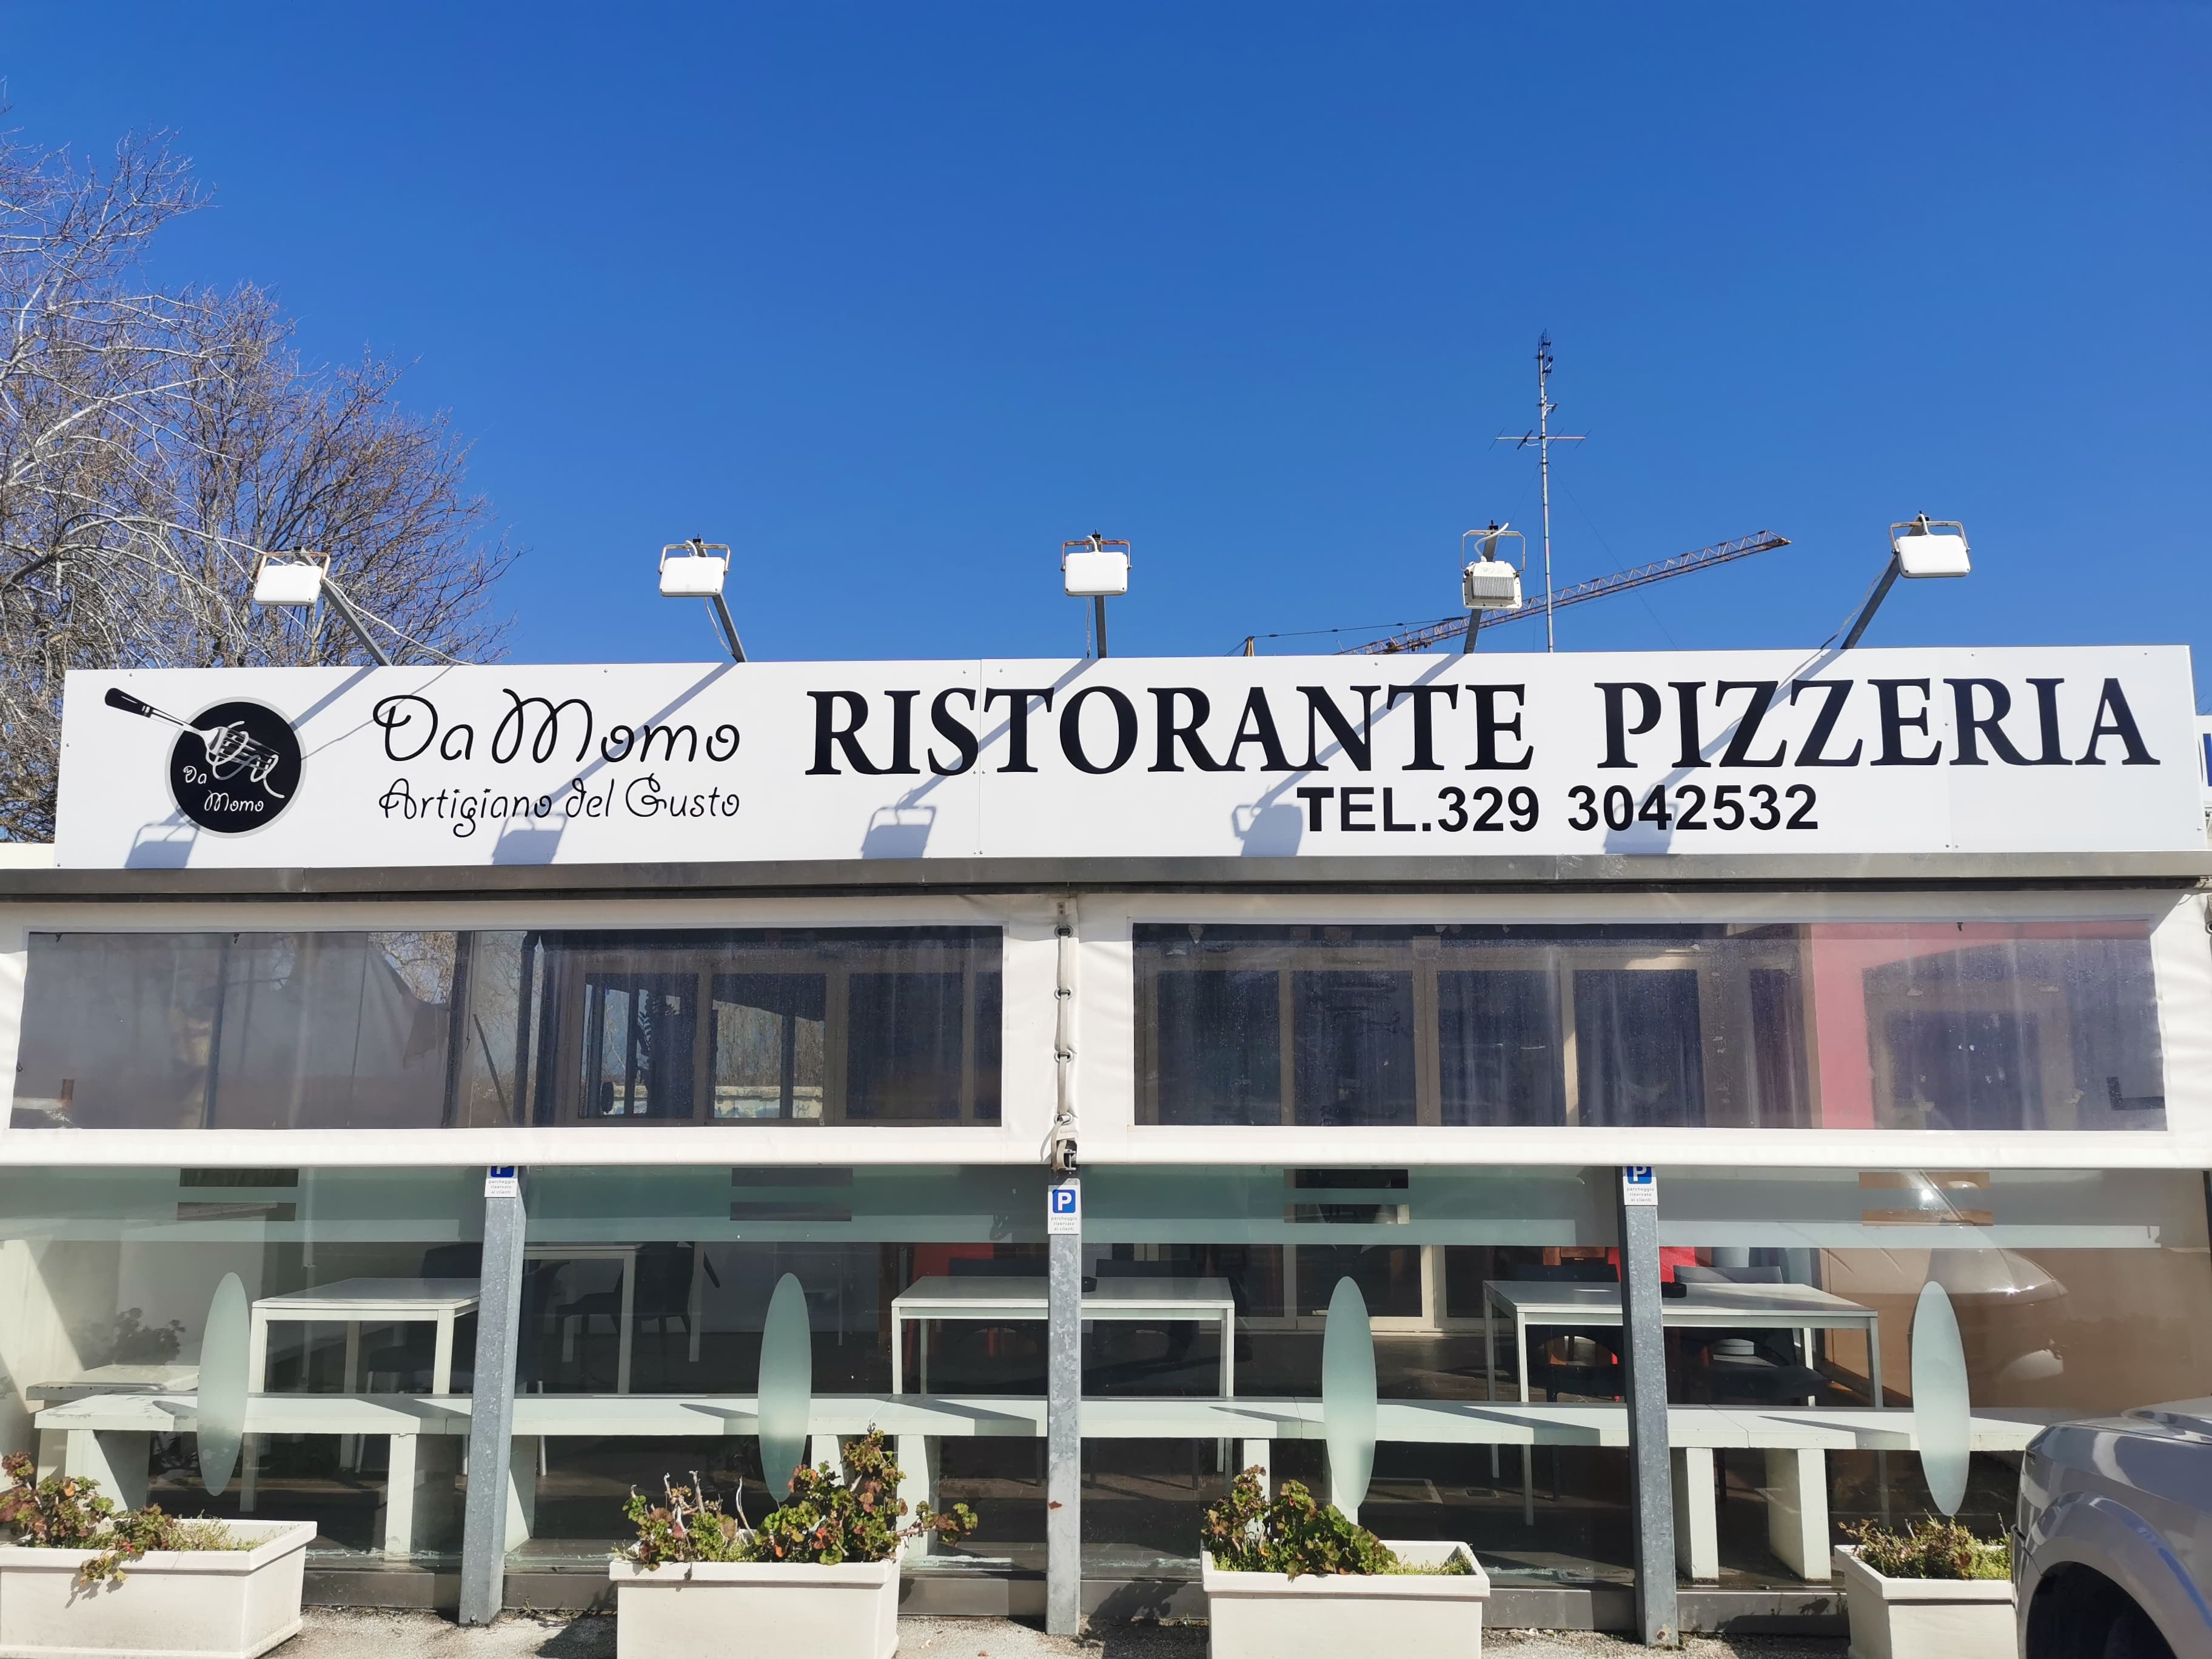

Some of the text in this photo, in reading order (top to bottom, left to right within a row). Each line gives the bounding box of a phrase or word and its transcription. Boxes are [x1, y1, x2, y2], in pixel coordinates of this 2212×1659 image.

[372, 688, 740, 764] Da Momo
[805, 684, 1533, 776] RISTORANTE
[1595, 679, 2160, 768] PIZZERIA
[183, 766, 207, 783] Da
[204, 790, 264, 811] Momo
[379, 773, 739, 838] Artigiano del Gusto
[1296, 783, 1818, 833] TEL.329 3042532
[1058, 1192, 1071, 1211] P
